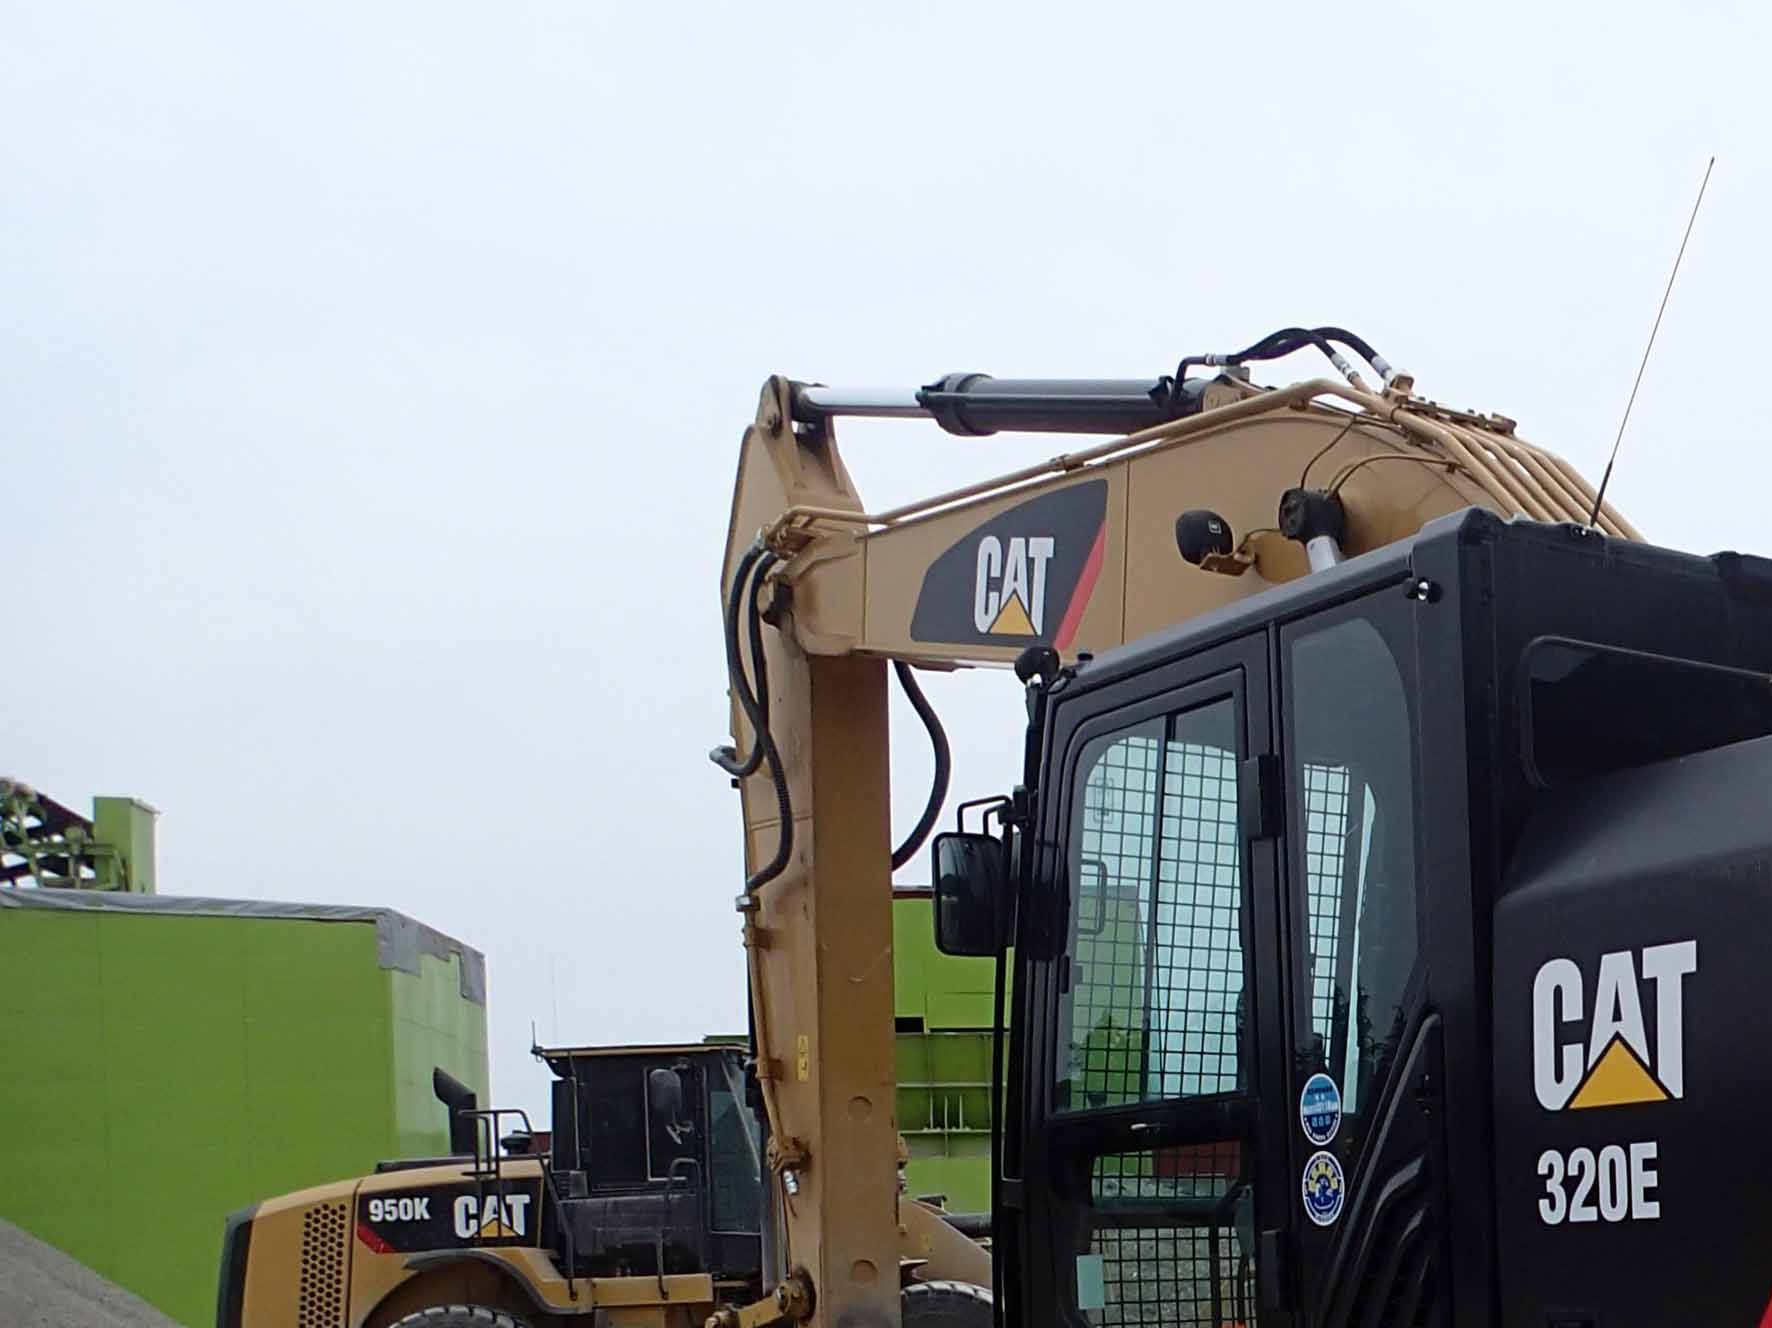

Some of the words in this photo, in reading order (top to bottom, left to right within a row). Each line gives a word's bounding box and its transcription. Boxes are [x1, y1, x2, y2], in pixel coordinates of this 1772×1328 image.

[974, 535, 1055, 636] CAT
[1533, 939, 1698, 1111] CAT
[368, 1196, 432, 1222] 950K
[453, 1193, 531, 1239] CAT
[1537, 1141, 1661, 1225] 320E
